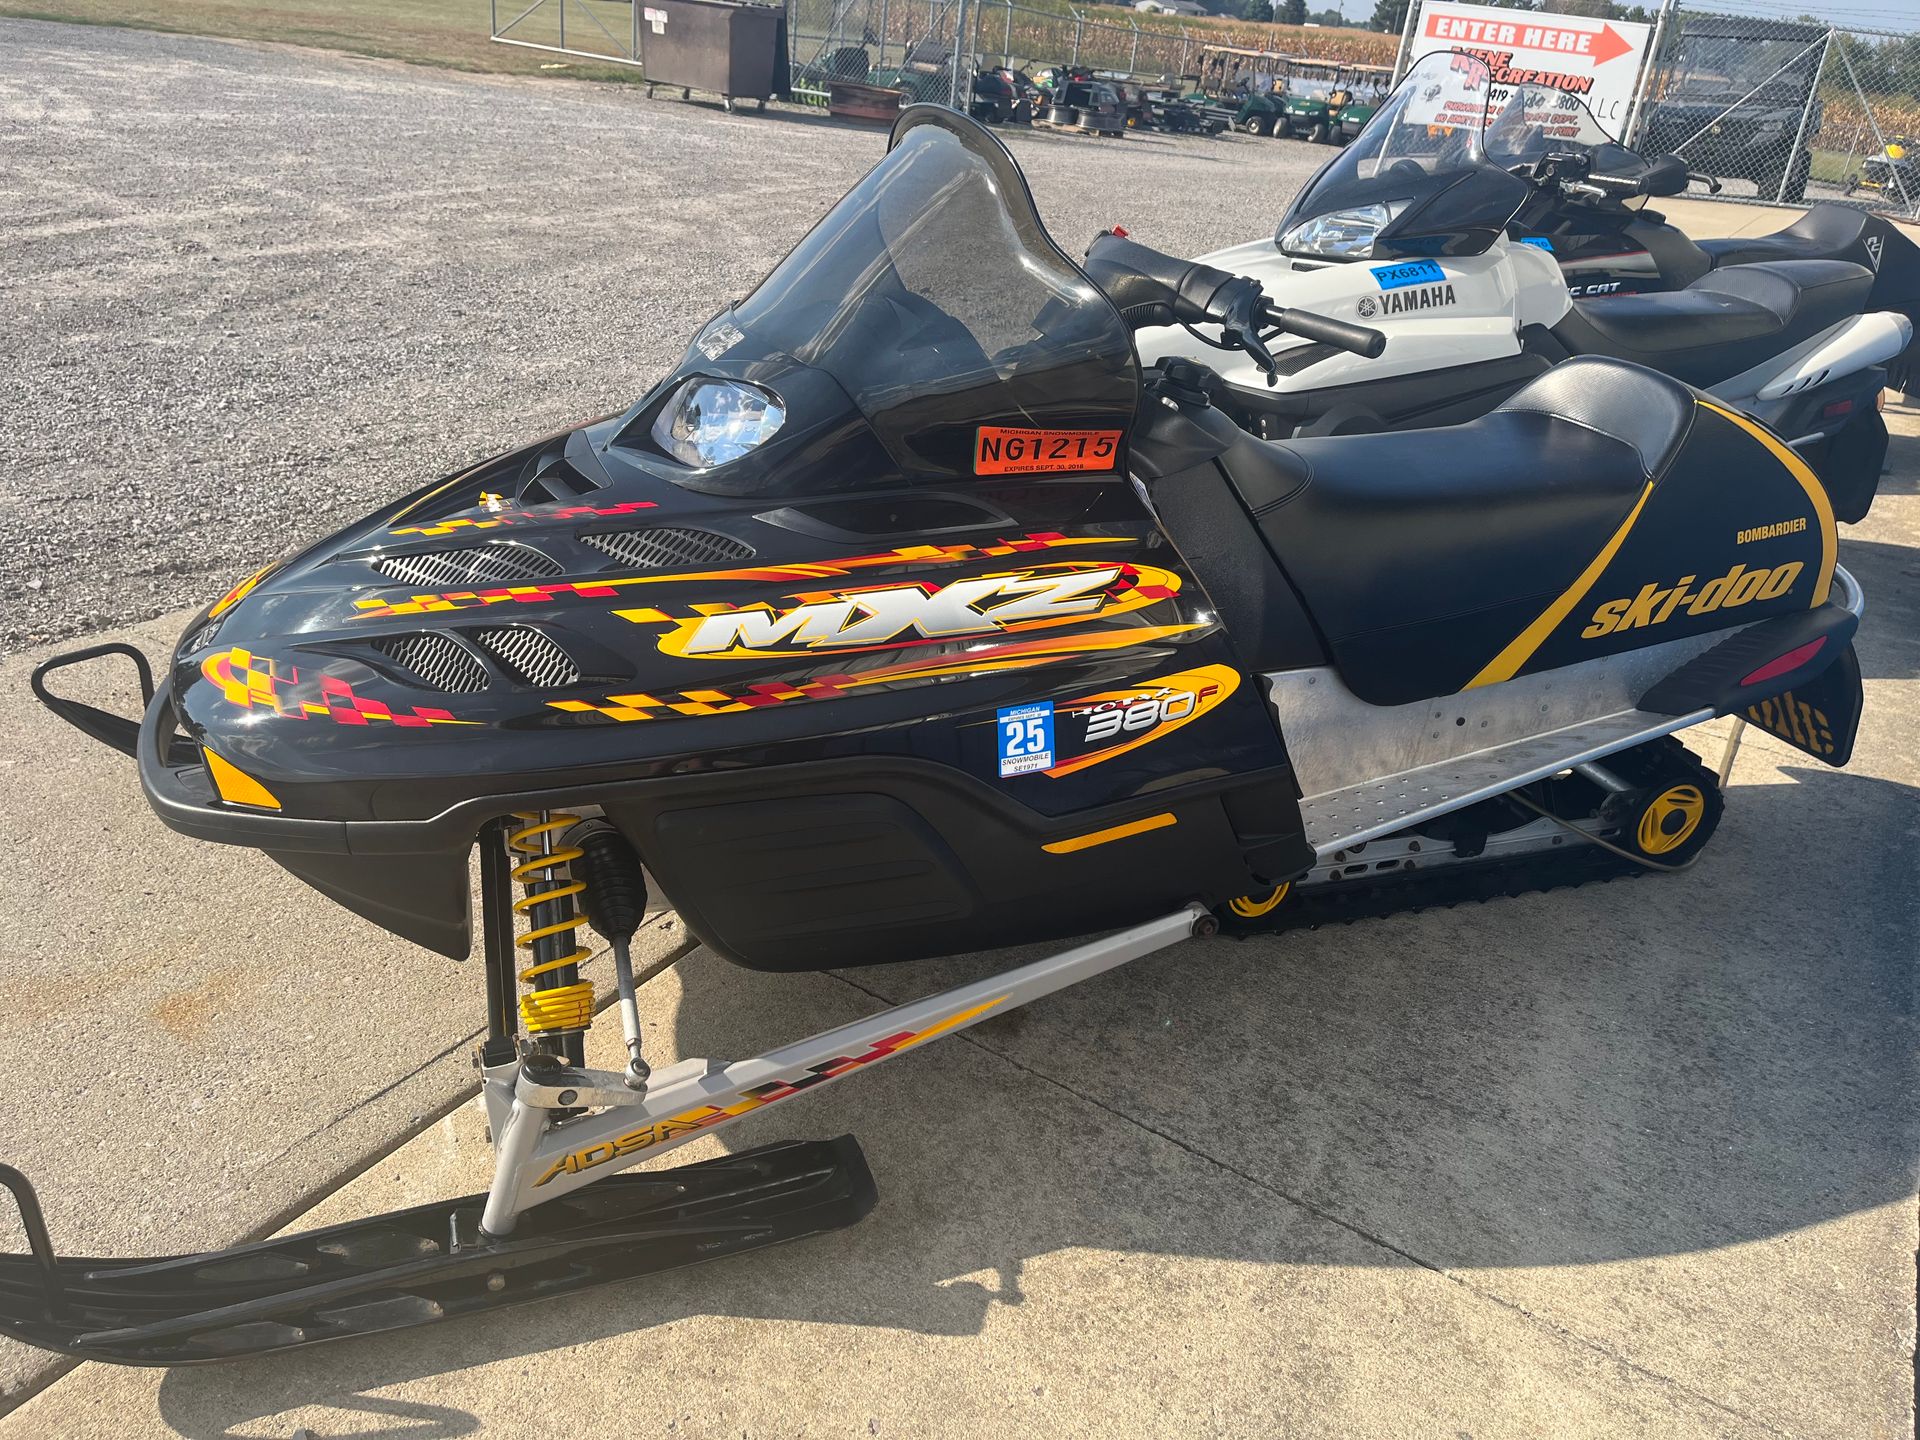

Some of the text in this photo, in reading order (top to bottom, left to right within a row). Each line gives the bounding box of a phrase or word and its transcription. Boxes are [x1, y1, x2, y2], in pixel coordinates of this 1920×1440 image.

[1435, 18, 1592, 53] ENTER HERE
[1463, 65, 1594, 95] RECREATION
[1376, 264, 1437, 282] PX6811
[1586, 281, 1621, 294] CAT
[1378, 284, 1456, 315] YAMAHA
[981, 436, 1116, 462] NG1215
[1737, 517, 1806, 545] BOMBARDIER
[682, 566, 1125, 654] MXZ
[1010, 706, 1041, 716] MICHIGAN
[1006, 718, 1045, 756] 25
[1002, 753, 1050, 766] SNOWMOBILE
[531, 1116, 702, 1188] ADSA
